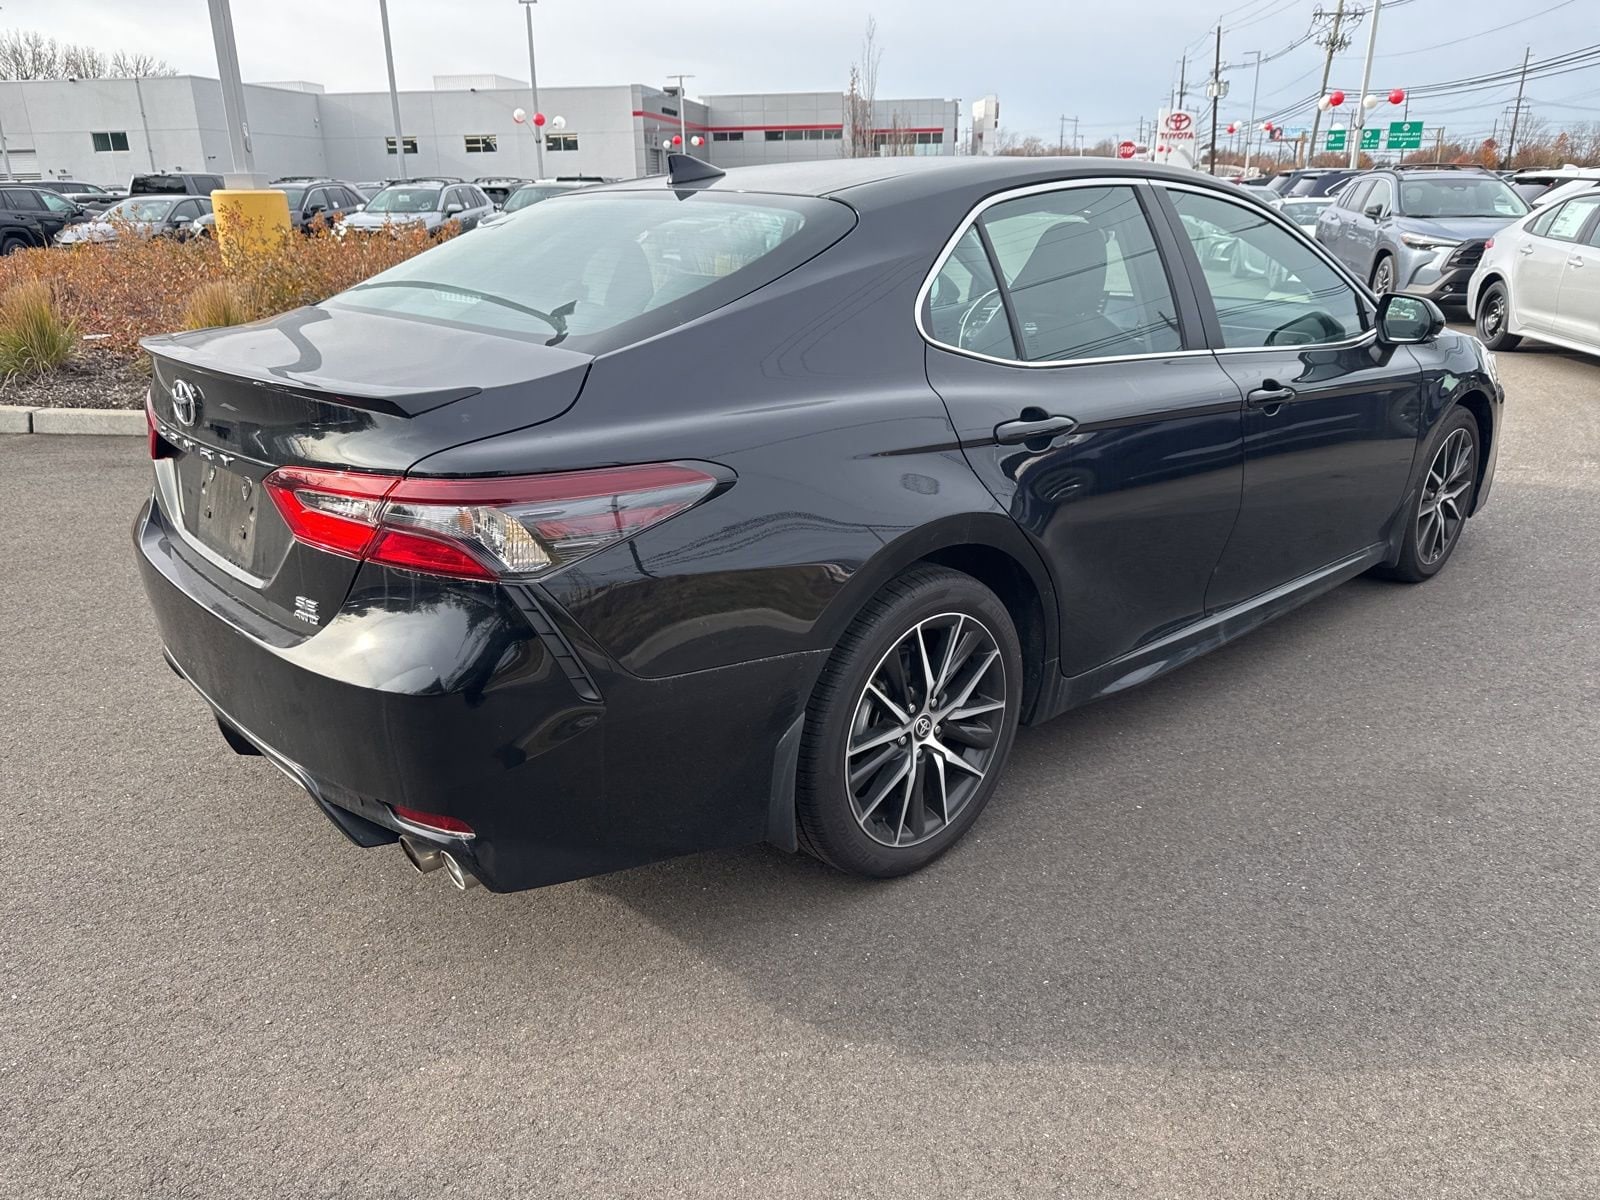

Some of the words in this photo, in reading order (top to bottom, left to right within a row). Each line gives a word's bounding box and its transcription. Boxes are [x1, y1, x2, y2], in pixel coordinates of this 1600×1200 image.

[1120, 146, 1135, 154] STOP
[295, 595, 320, 612] SE
[293, 609, 321, 626] AWD
